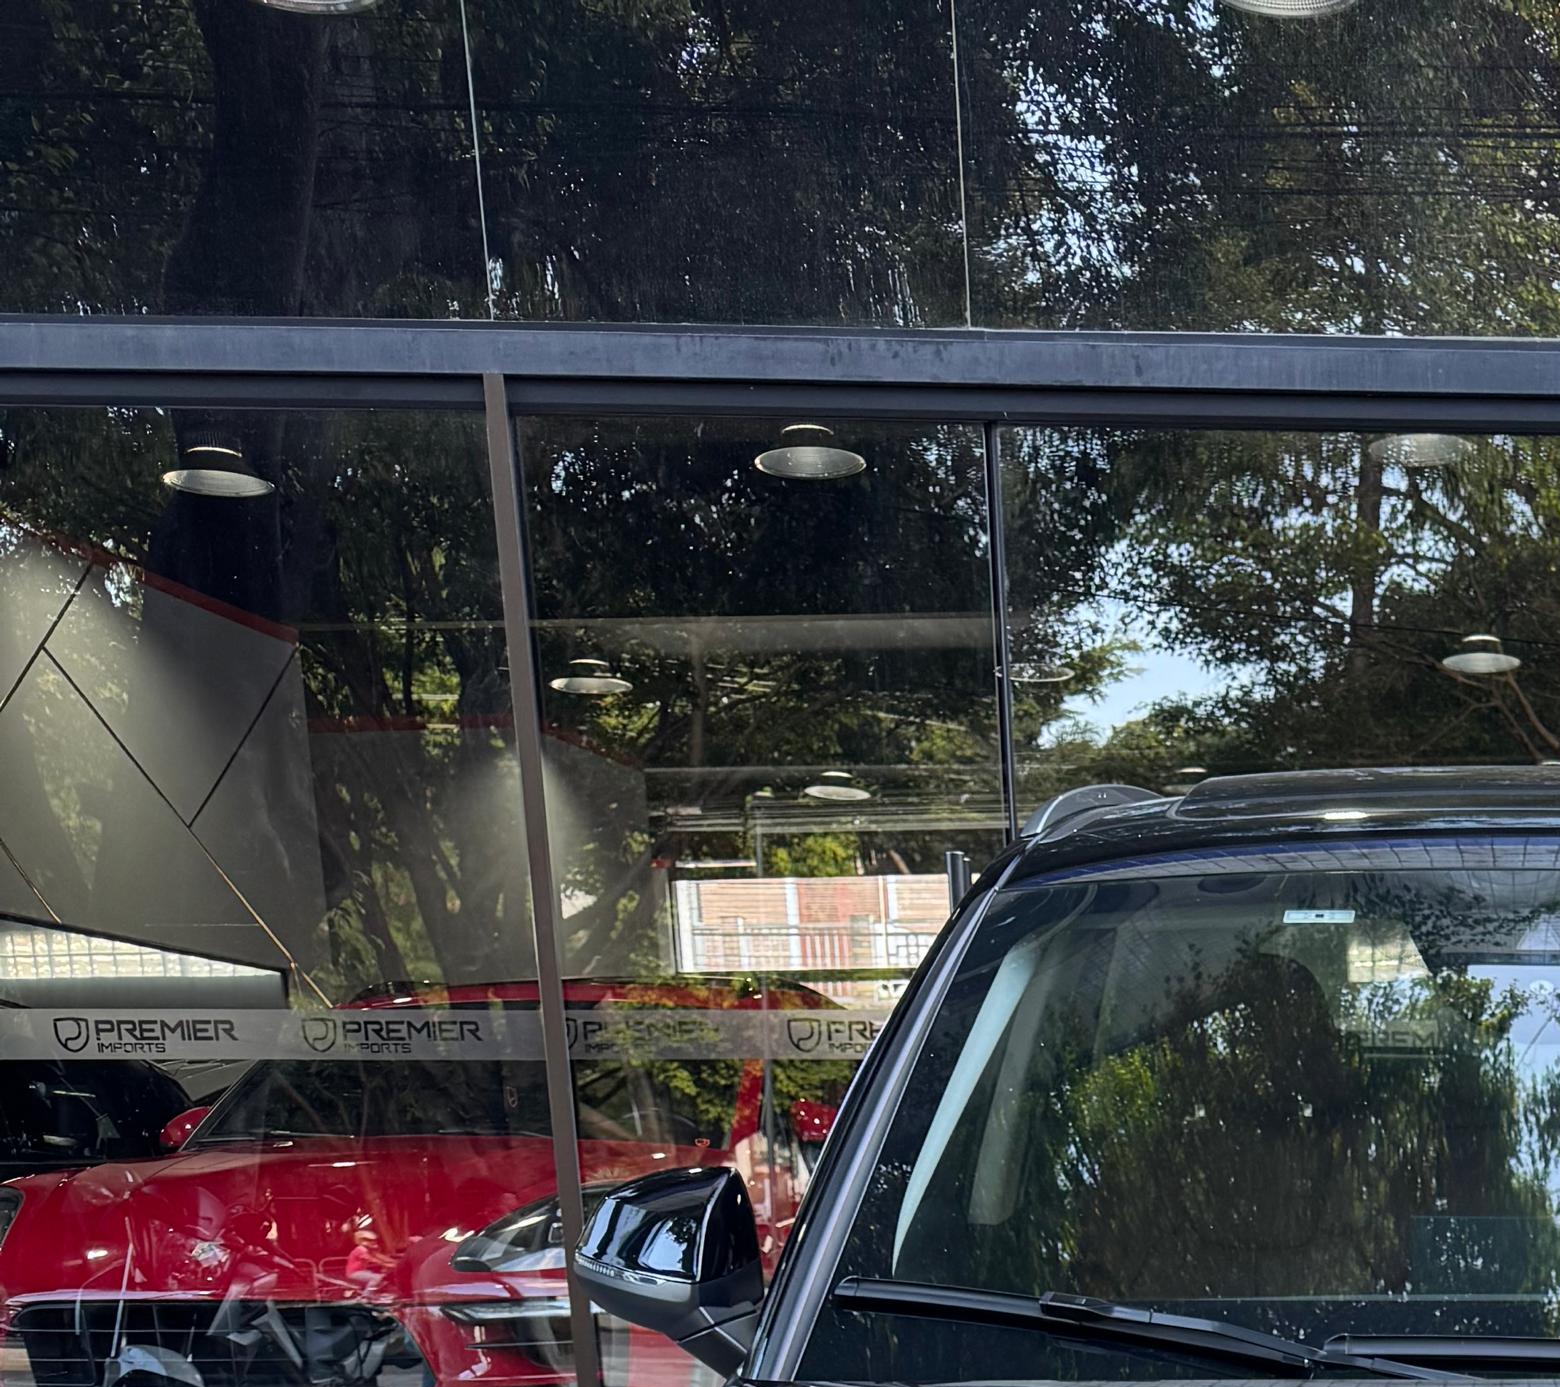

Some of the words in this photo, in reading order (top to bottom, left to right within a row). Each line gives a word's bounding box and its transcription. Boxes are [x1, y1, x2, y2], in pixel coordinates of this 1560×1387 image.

[94, 1019, 239, 1041] PREMIER
[342, 1020, 483, 1041] PREMIER
[97, 1042, 166, 1054] IMPORTS
